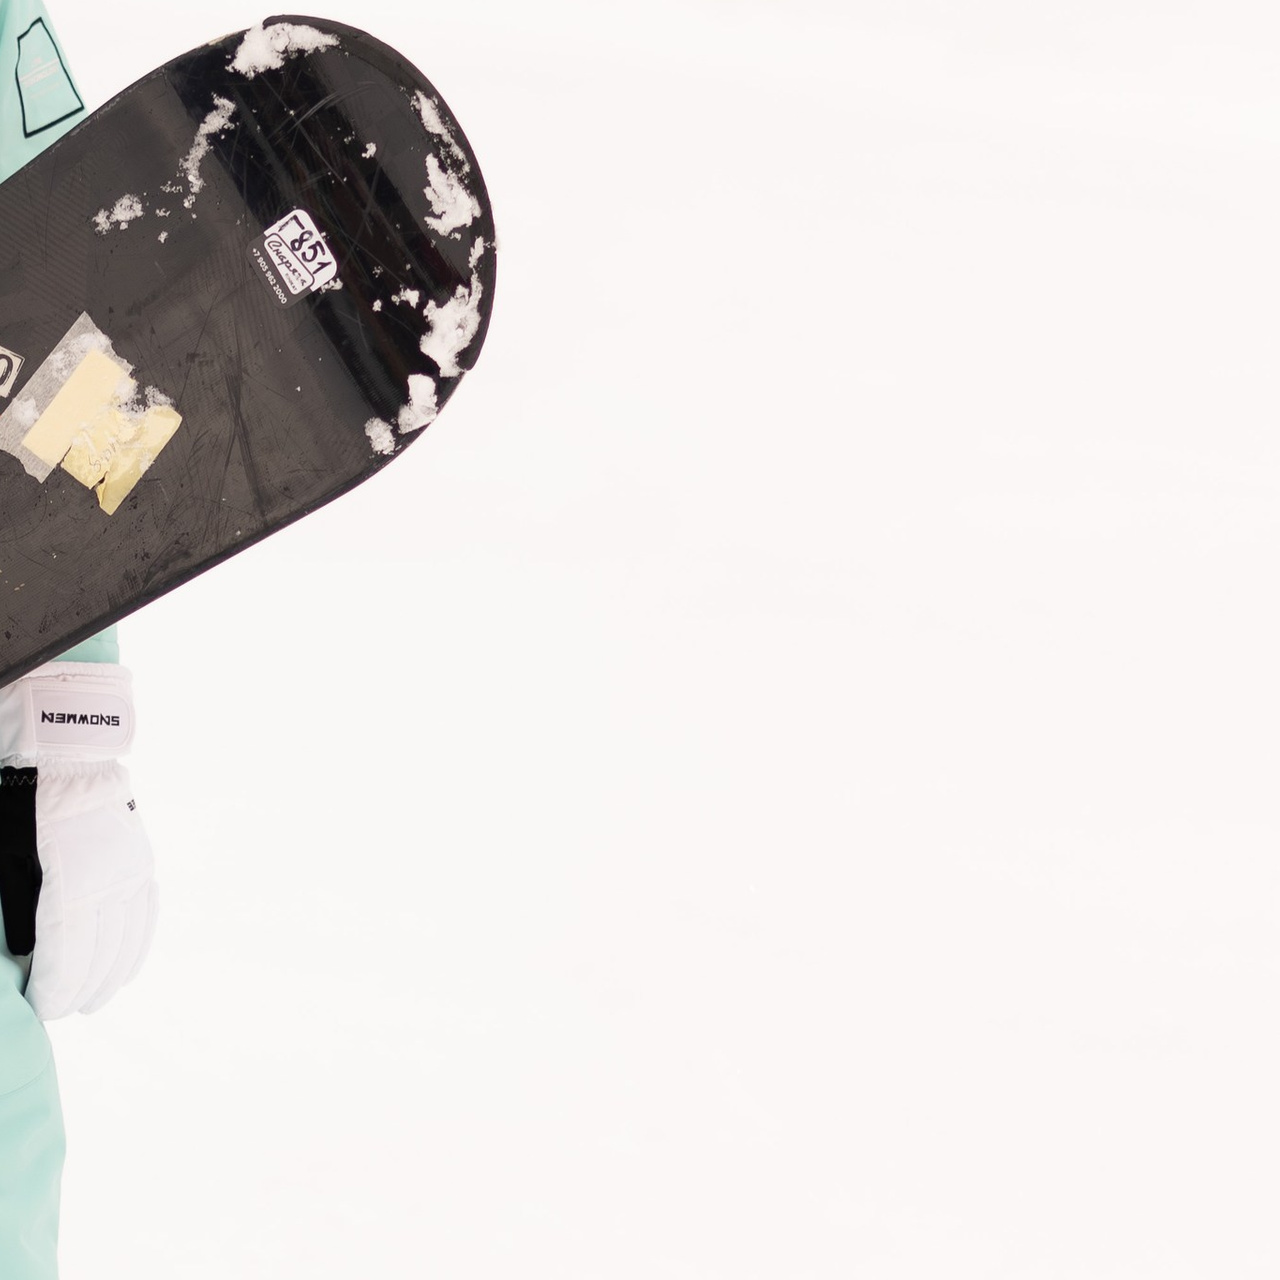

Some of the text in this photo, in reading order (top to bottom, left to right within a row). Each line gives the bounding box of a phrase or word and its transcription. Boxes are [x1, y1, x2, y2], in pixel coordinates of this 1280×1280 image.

[257, 256, 270, 272] 905
[265, 270, 277, 287] 962
[273, 284, 288, 305] 2000
[41, 710, 120, 727] SNOWMEN
